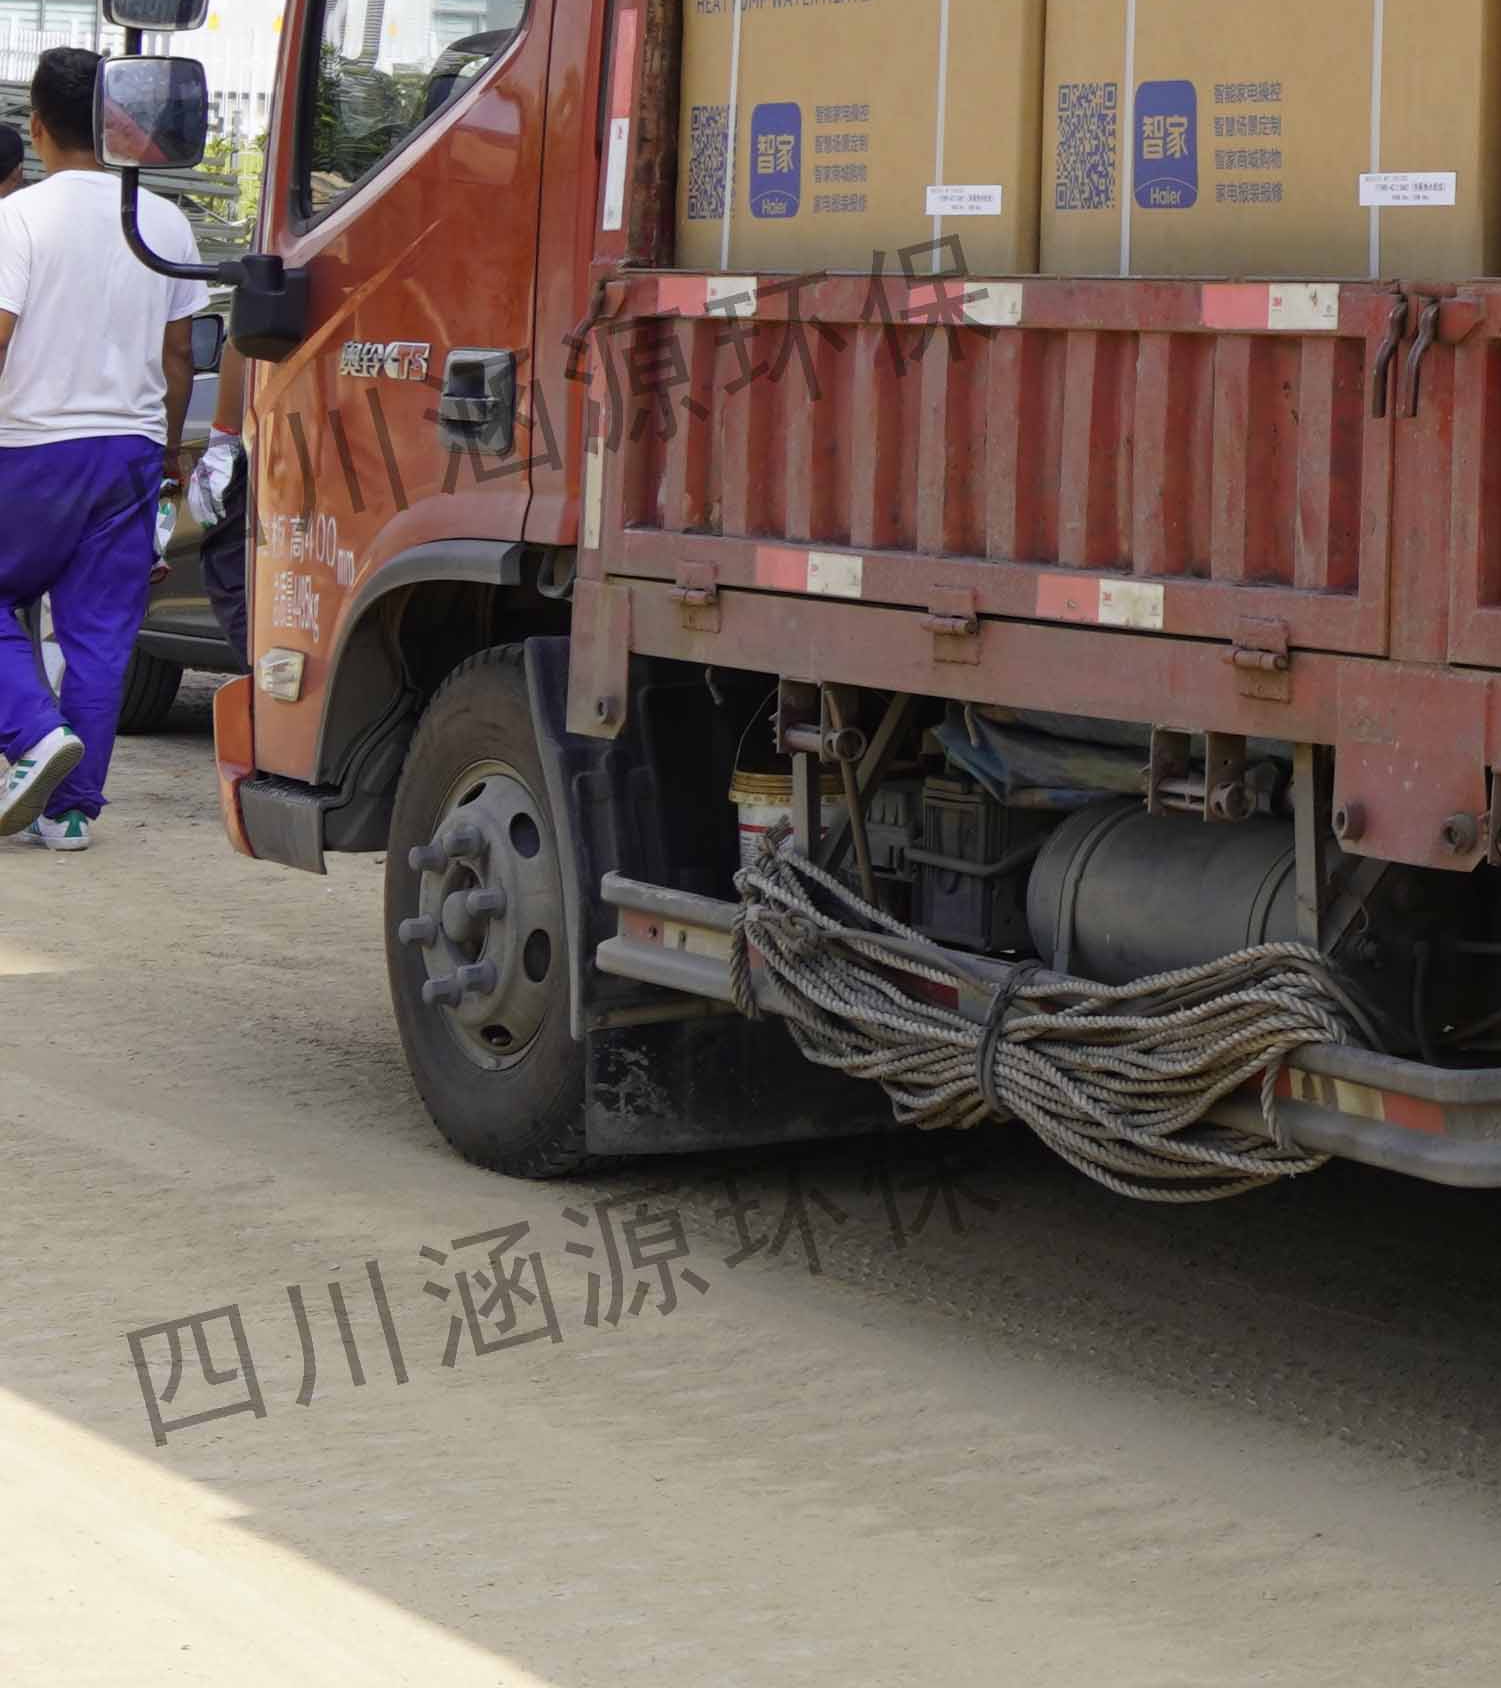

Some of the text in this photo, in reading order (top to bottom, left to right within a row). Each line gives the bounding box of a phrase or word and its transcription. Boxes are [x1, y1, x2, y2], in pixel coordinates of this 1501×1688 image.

[757, 134, 795, 174] 智家
[1143, 115, 1188, 159] 智家
[1151, 186, 1181, 204] Haier
